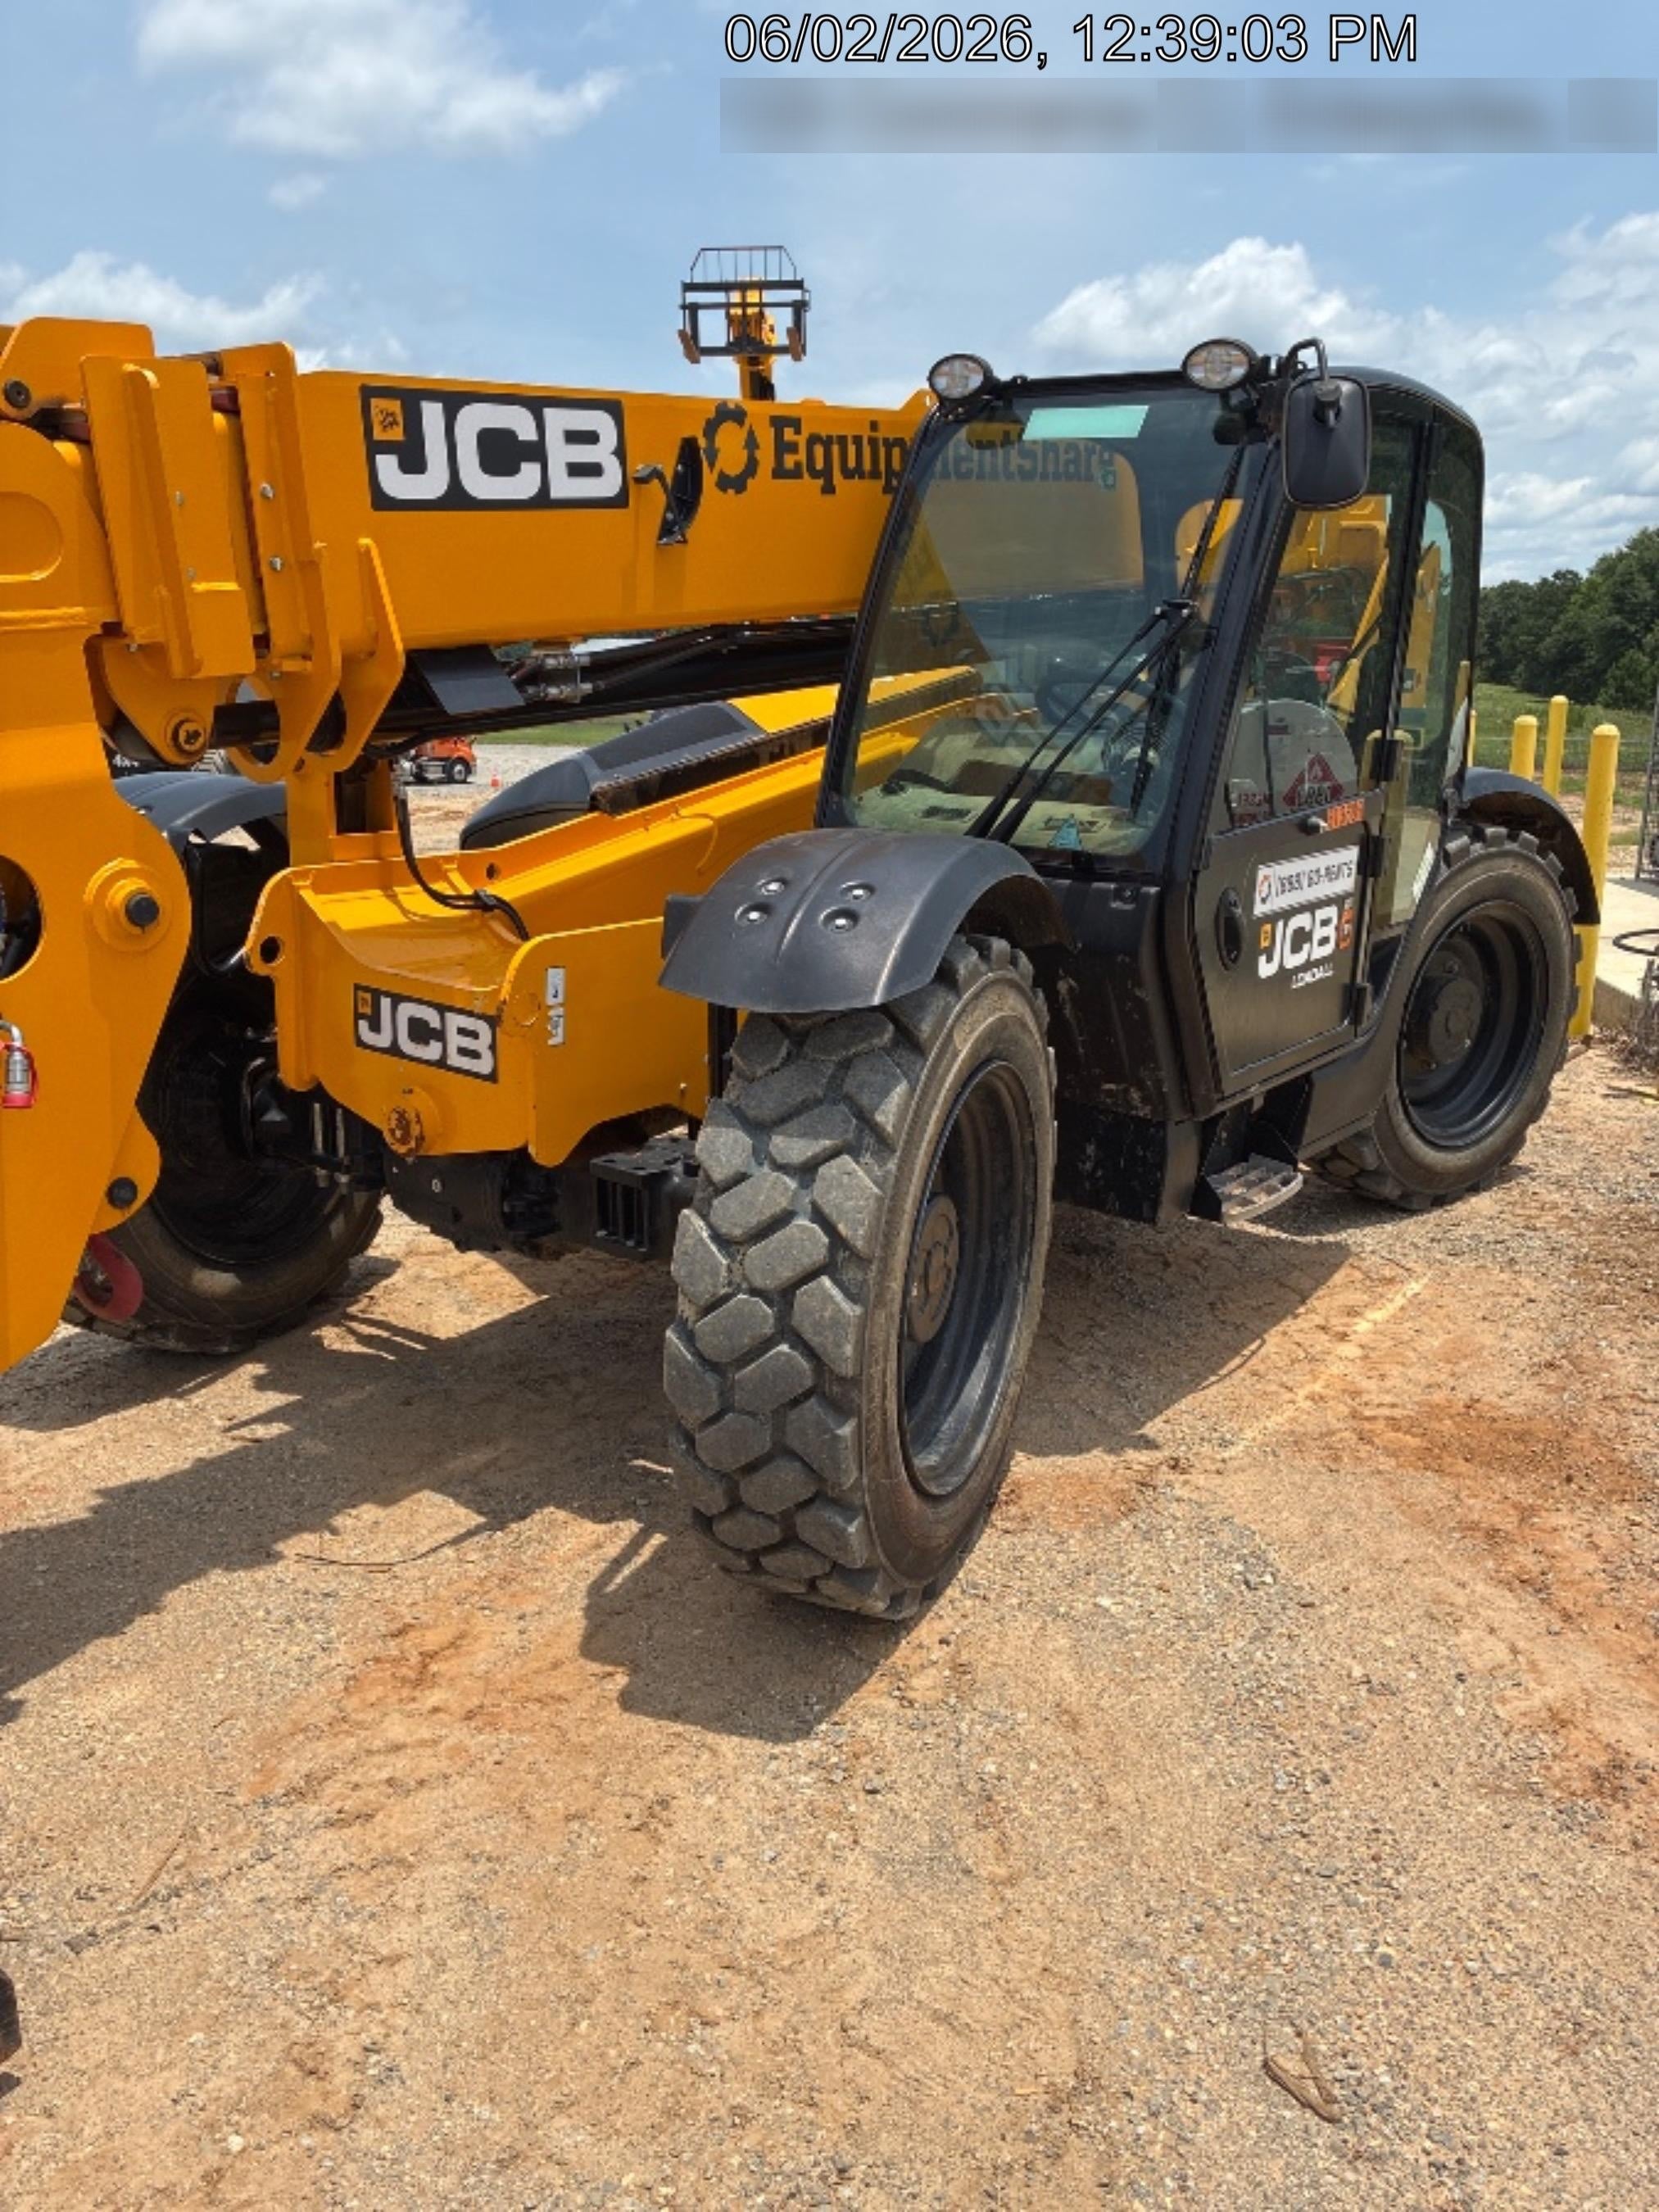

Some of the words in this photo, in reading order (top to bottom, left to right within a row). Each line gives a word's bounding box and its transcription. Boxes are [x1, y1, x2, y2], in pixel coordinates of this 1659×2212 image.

[374, 399, 623, 500] JCB
[1258, 904, 1338, 979] JCB
[357, 996, 496, 1076] JCB
